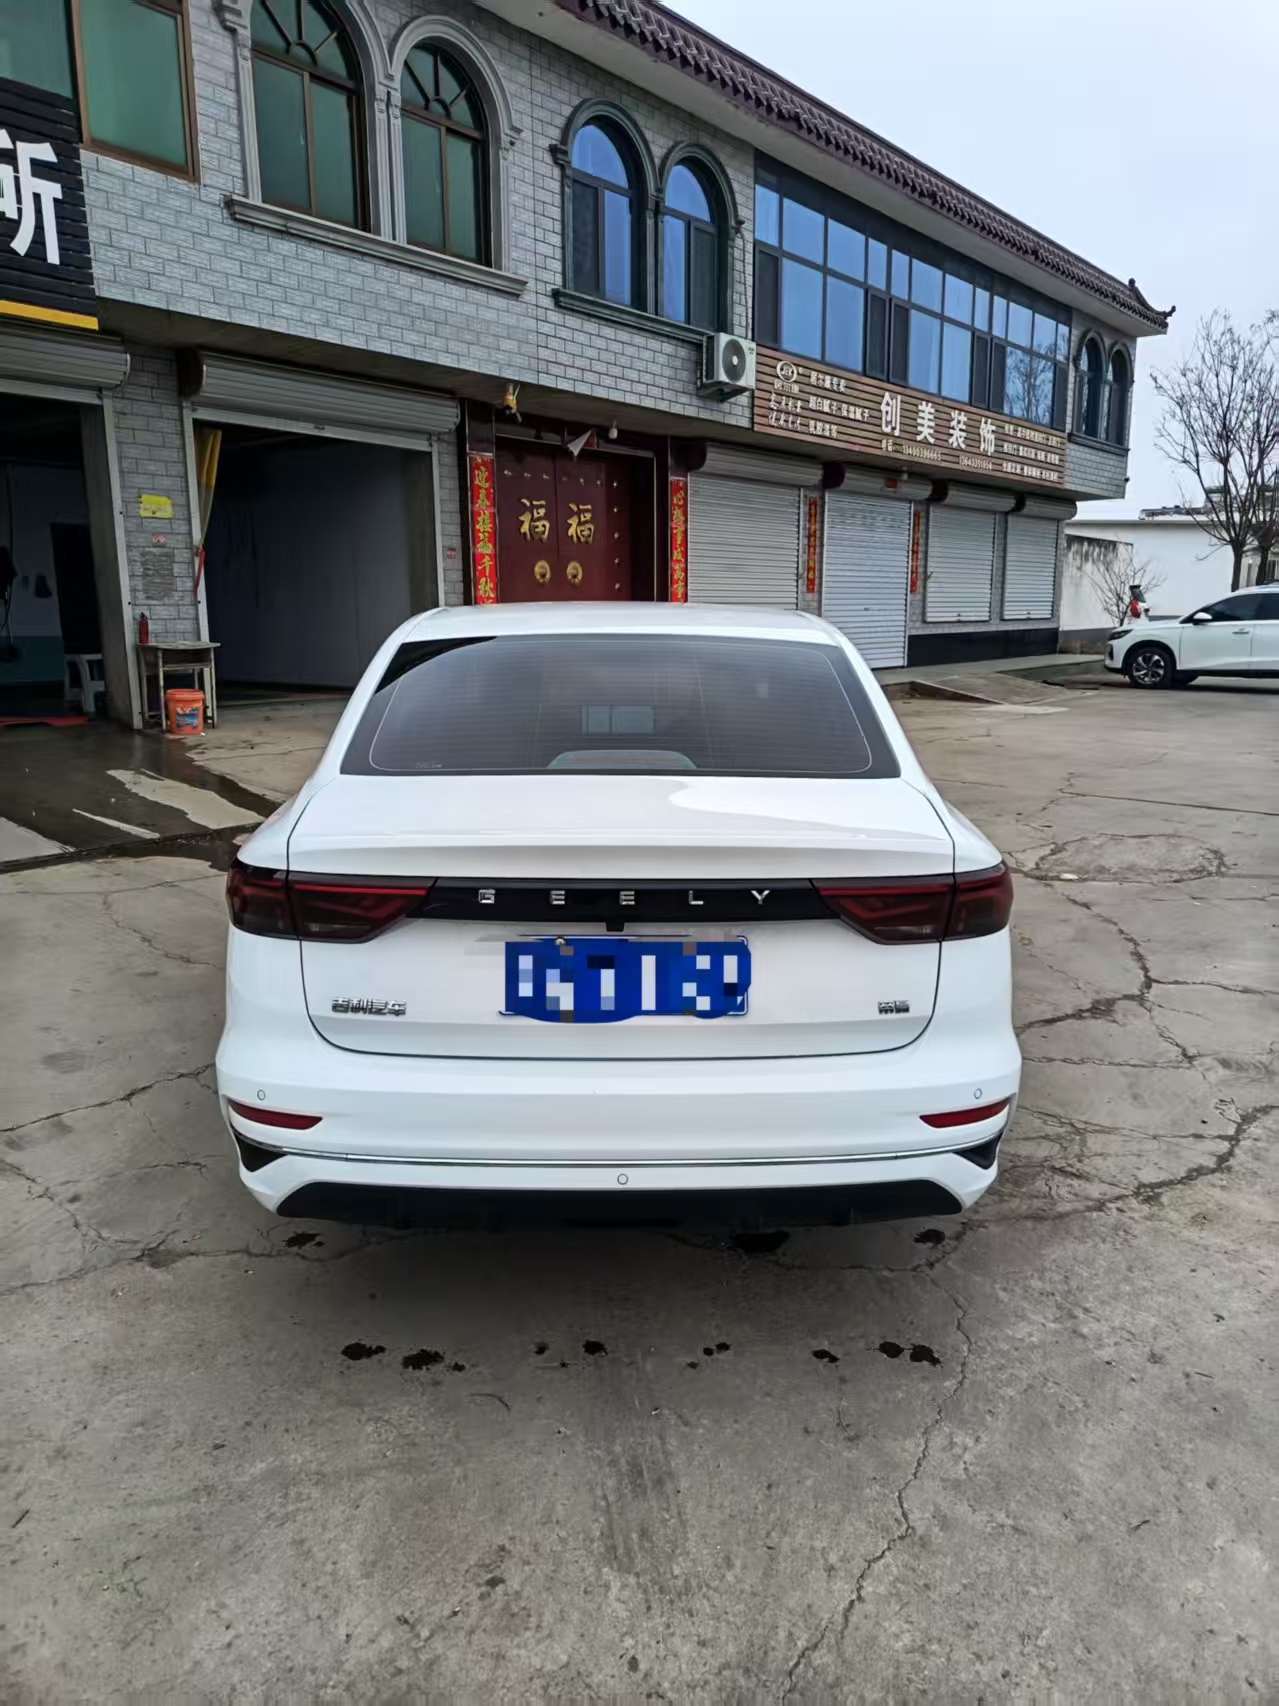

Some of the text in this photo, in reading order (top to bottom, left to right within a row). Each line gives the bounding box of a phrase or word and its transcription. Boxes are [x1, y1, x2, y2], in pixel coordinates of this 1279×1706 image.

[880, 391, 997, 456] 创美装饰
[474, 466, 496, 604] 迎春接福千秋
[519, 498, 595, 544] 福 福
[478, 888, 770, 905] GEELY
